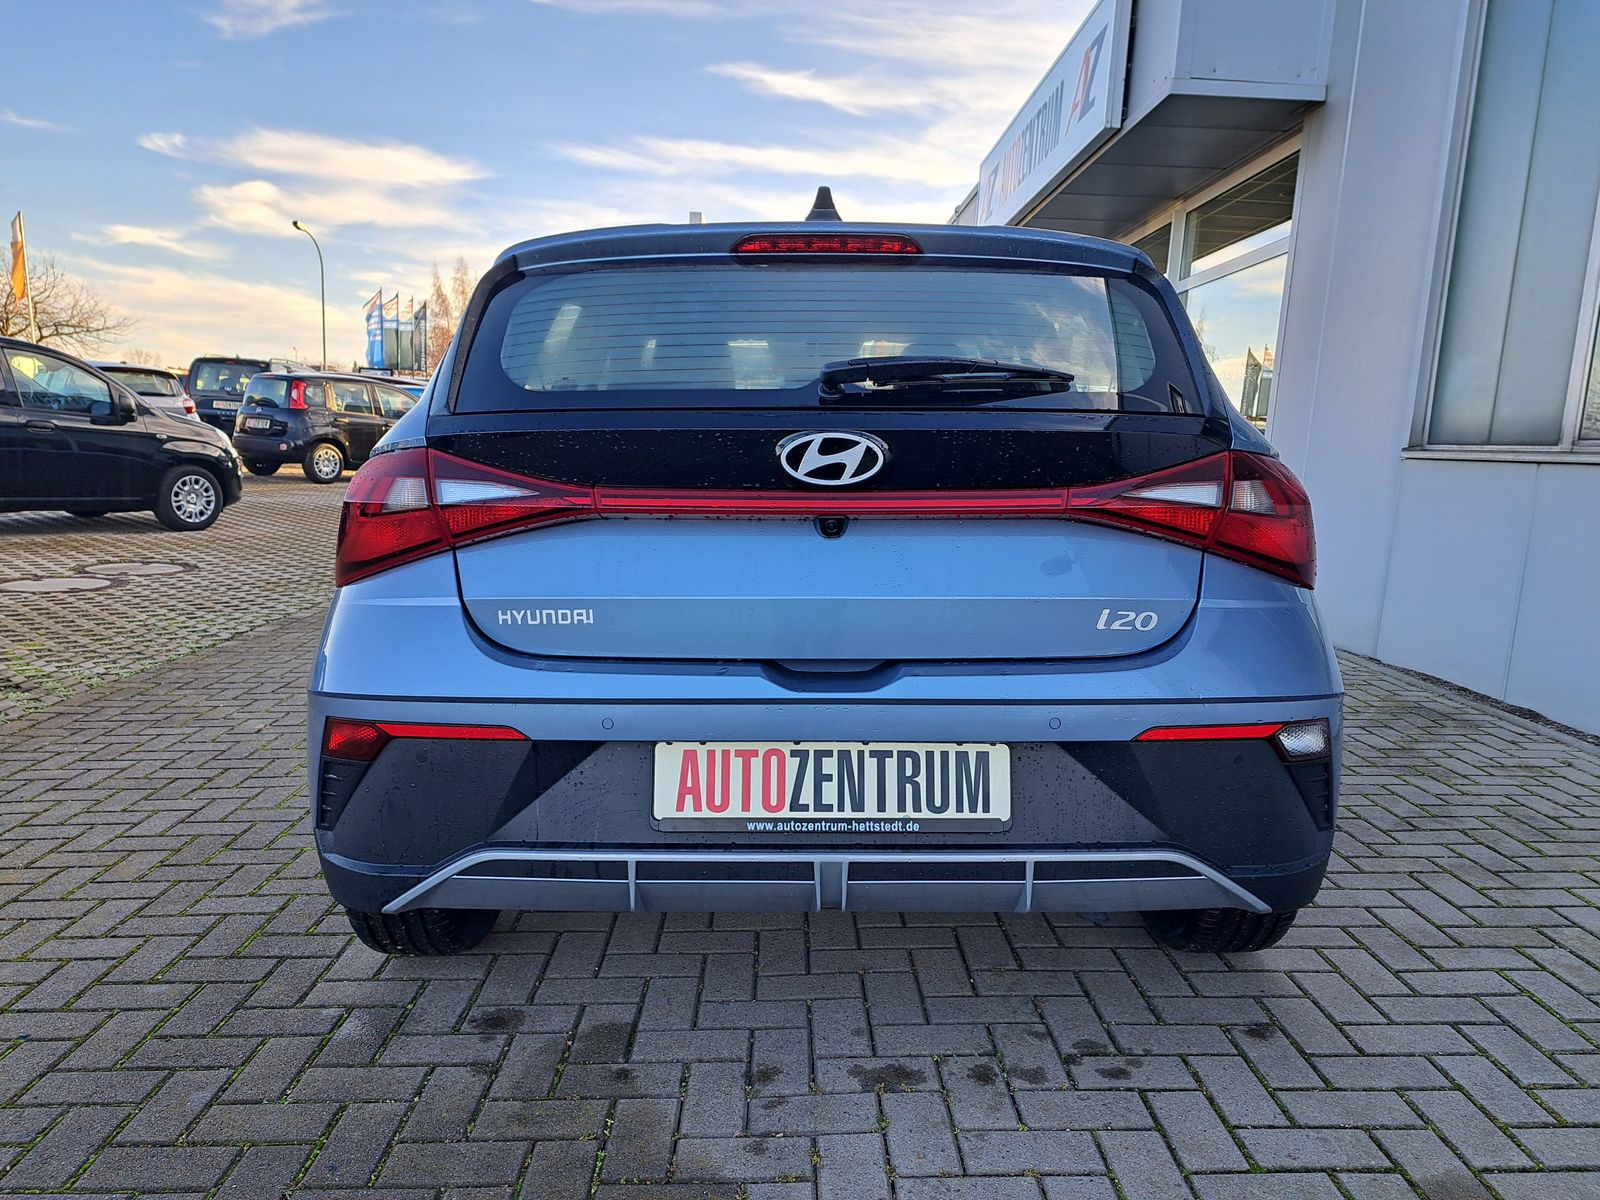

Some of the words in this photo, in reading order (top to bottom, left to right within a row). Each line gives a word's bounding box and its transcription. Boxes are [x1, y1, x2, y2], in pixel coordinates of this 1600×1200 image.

[1001, 78, 1065, 205] AUTOZENTRUM
[1064, 22, 1109, 138] AZ
[498, 608, 594, 625] HYUNDAI
[675, 748, 991, 814] AUTOZENTRUM
[746, 820, 920, 833] www.autozentrum-hettstedt.de
